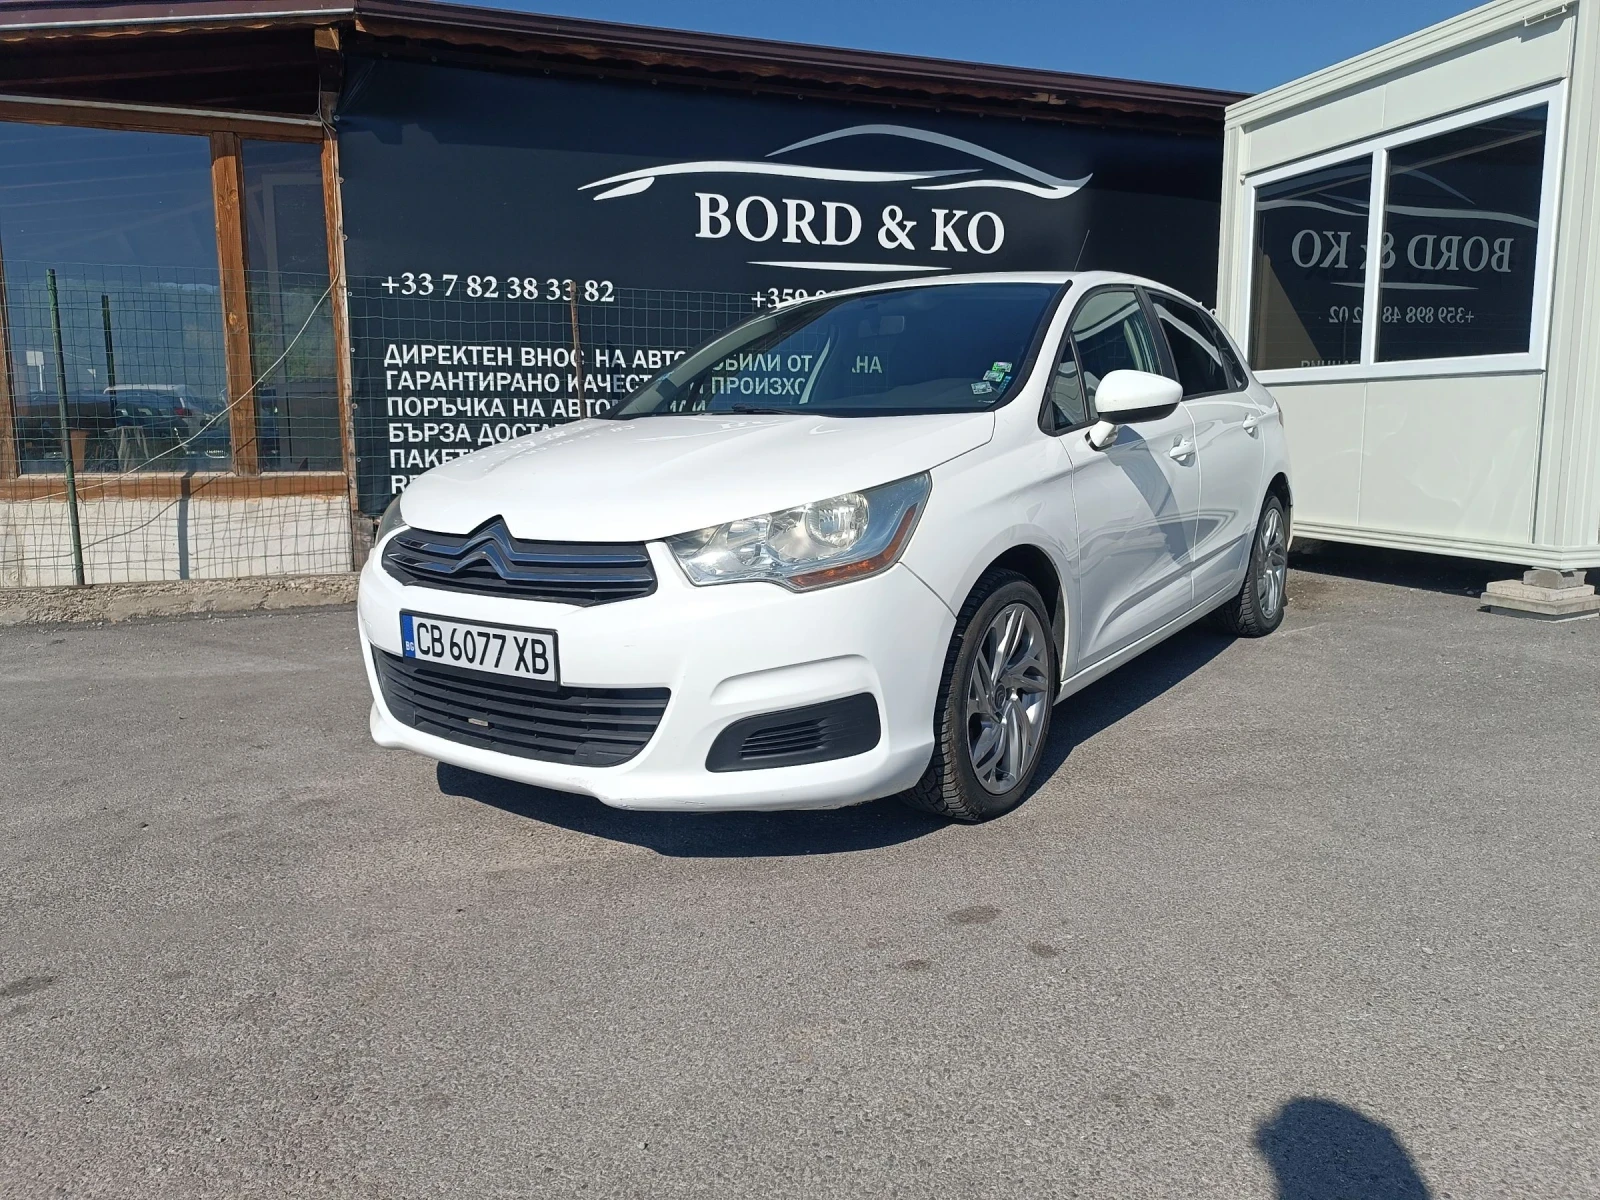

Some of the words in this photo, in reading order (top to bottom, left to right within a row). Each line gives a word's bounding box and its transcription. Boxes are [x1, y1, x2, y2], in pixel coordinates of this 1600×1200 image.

[695, 192, 862, 245] BORD
[877, 205, 917, 250] &
[931, 208, 1005, 255] KO
[381, 272, 434, 296] +33
[442, 274, 458, 296] 7
[466, 275, 499, 299] 82
[507, 277, 539, 300] 38
[546, 278, 573, 301] 33
[584, 280, 615, 302] 82
[384, 344, 512, 367] ДИРЕКТЕН
[521, 347, 584, 367] ВНОС
[595, 349, 627, 368] НА
[787, 354, 813, 373] ОТ
[386, 370, 560, 392] ГАРАНТИРАНО
[387, 397, 506, 417] ПОРЪЧКА
[513, 398, 545, 417] НА
[388, 423, 472, 443] БЪРЗА
[405, 641, 415, 652] BG
[417, 622, 444, 658] CB
[449, 627, 507, 669] 6077
[513, 636, 549, 675] XB
